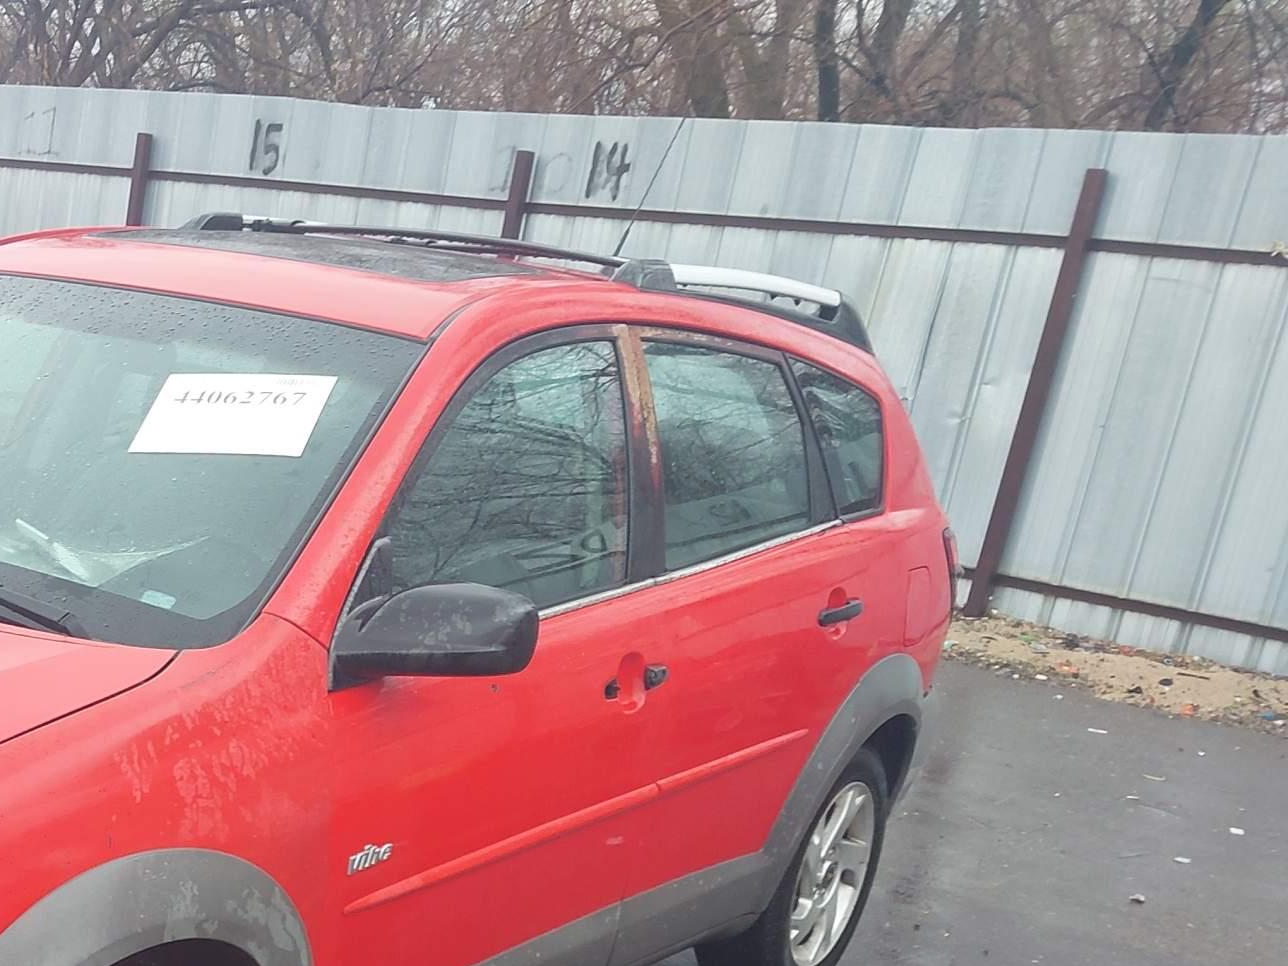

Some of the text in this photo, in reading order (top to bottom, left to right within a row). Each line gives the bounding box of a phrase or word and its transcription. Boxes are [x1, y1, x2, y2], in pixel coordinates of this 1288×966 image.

[249, 118, 284, 176] 15
[584, 140, 632, 201] 14
[173, 390, 308, 406] 44062767
